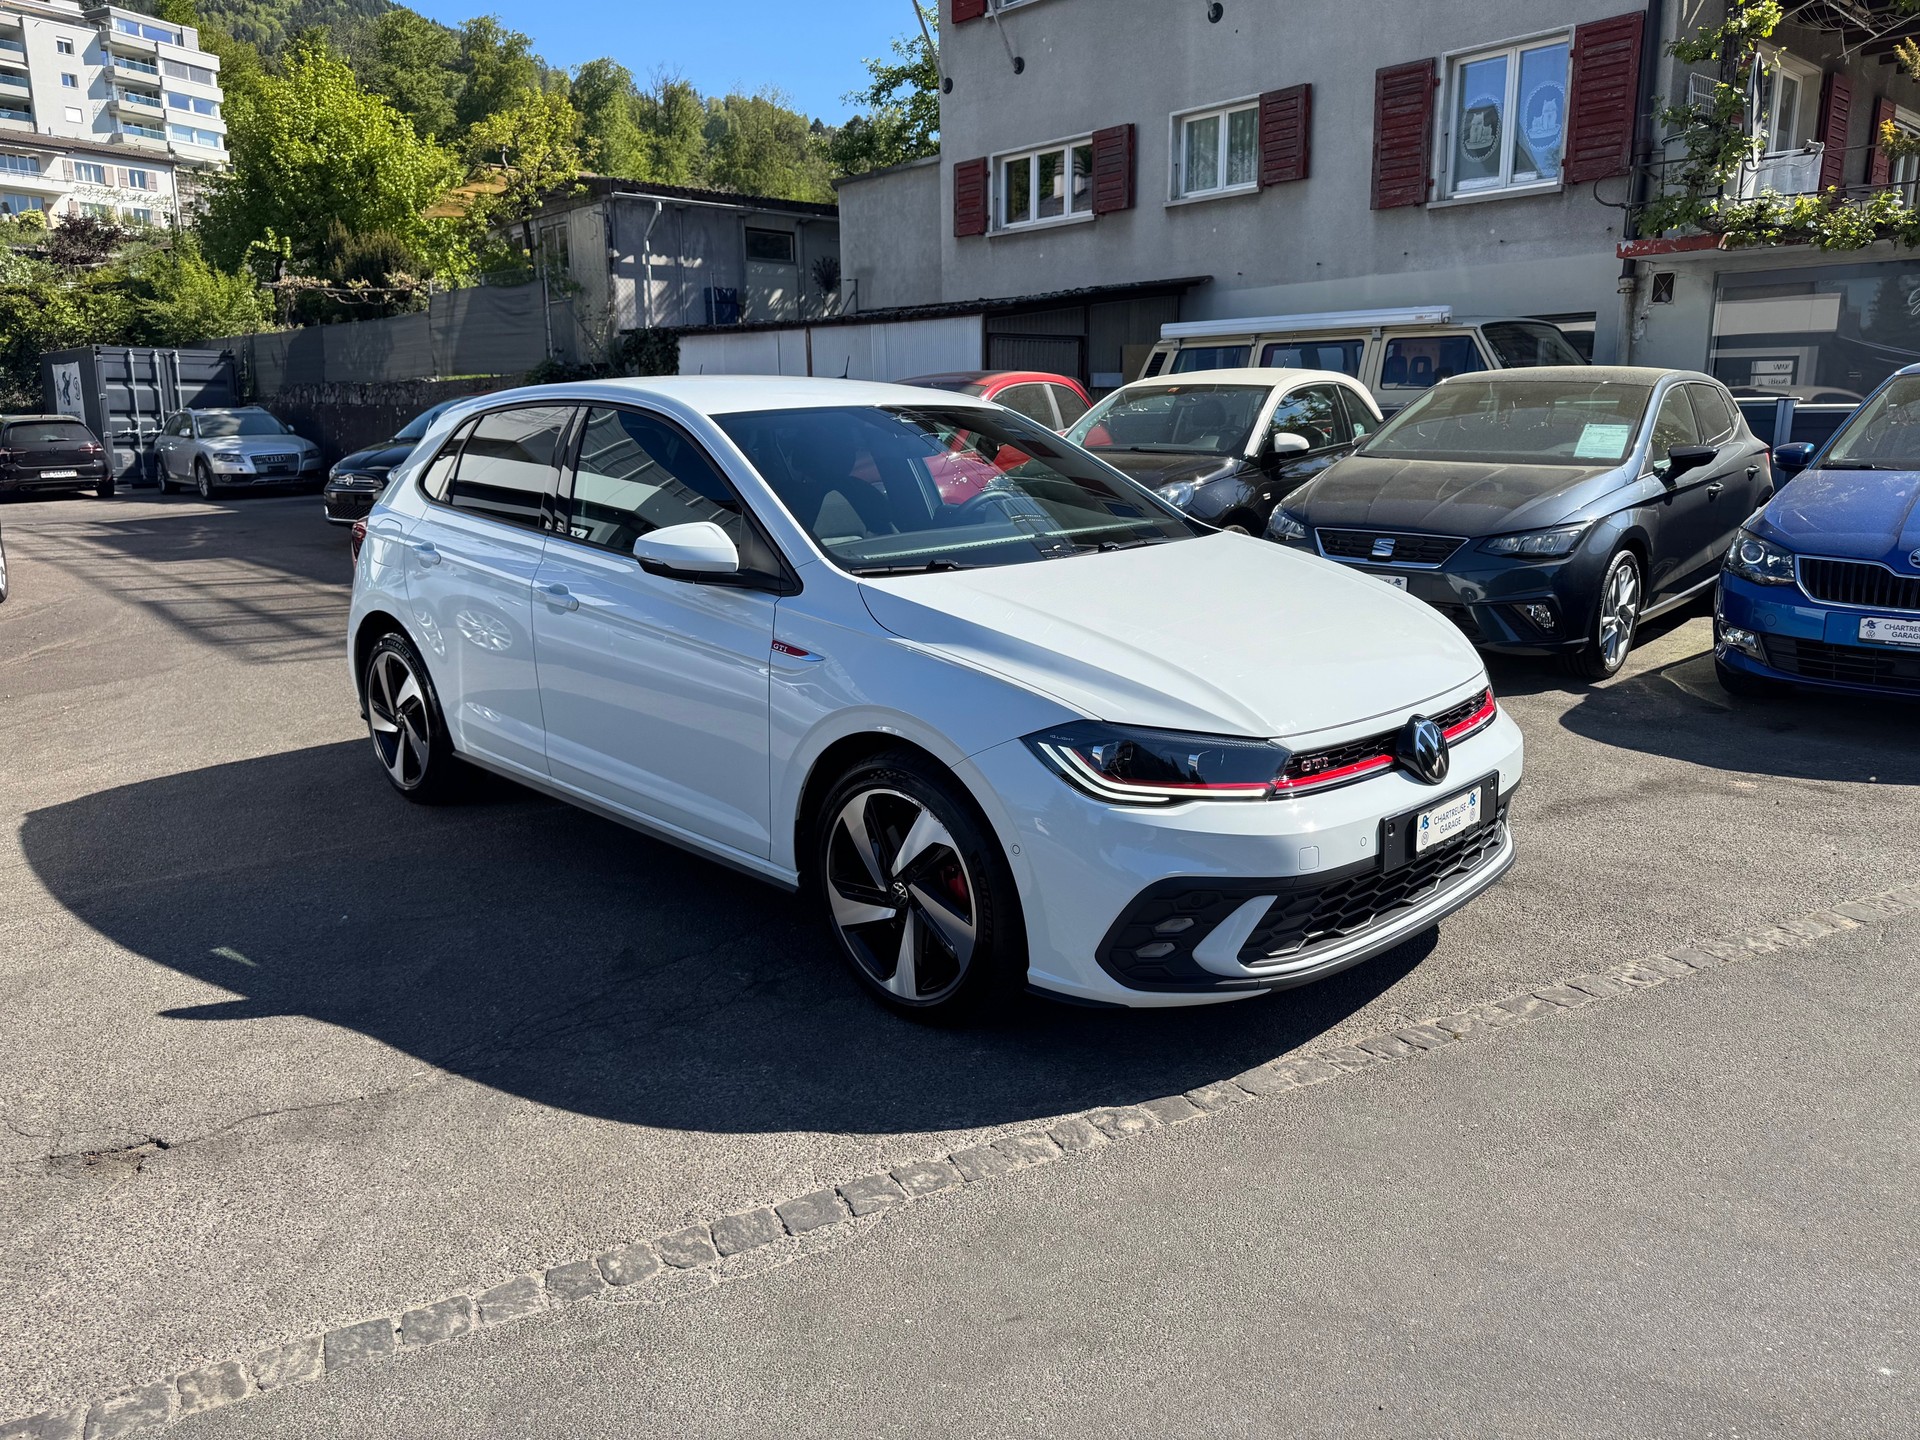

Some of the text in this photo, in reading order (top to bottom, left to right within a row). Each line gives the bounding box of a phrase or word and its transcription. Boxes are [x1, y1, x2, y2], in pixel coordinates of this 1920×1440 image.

[1884, 623, 1920, 632] CHARTRE
[1891, 631, 1920, 640] GARAG
[773, 643, 788, 652] GTI
[1301, 756, 1329, 772] GTI
[1433, 802, 1467, 825] CHARTREUSE
[1439, 816, 1462, 834] GARAGE
